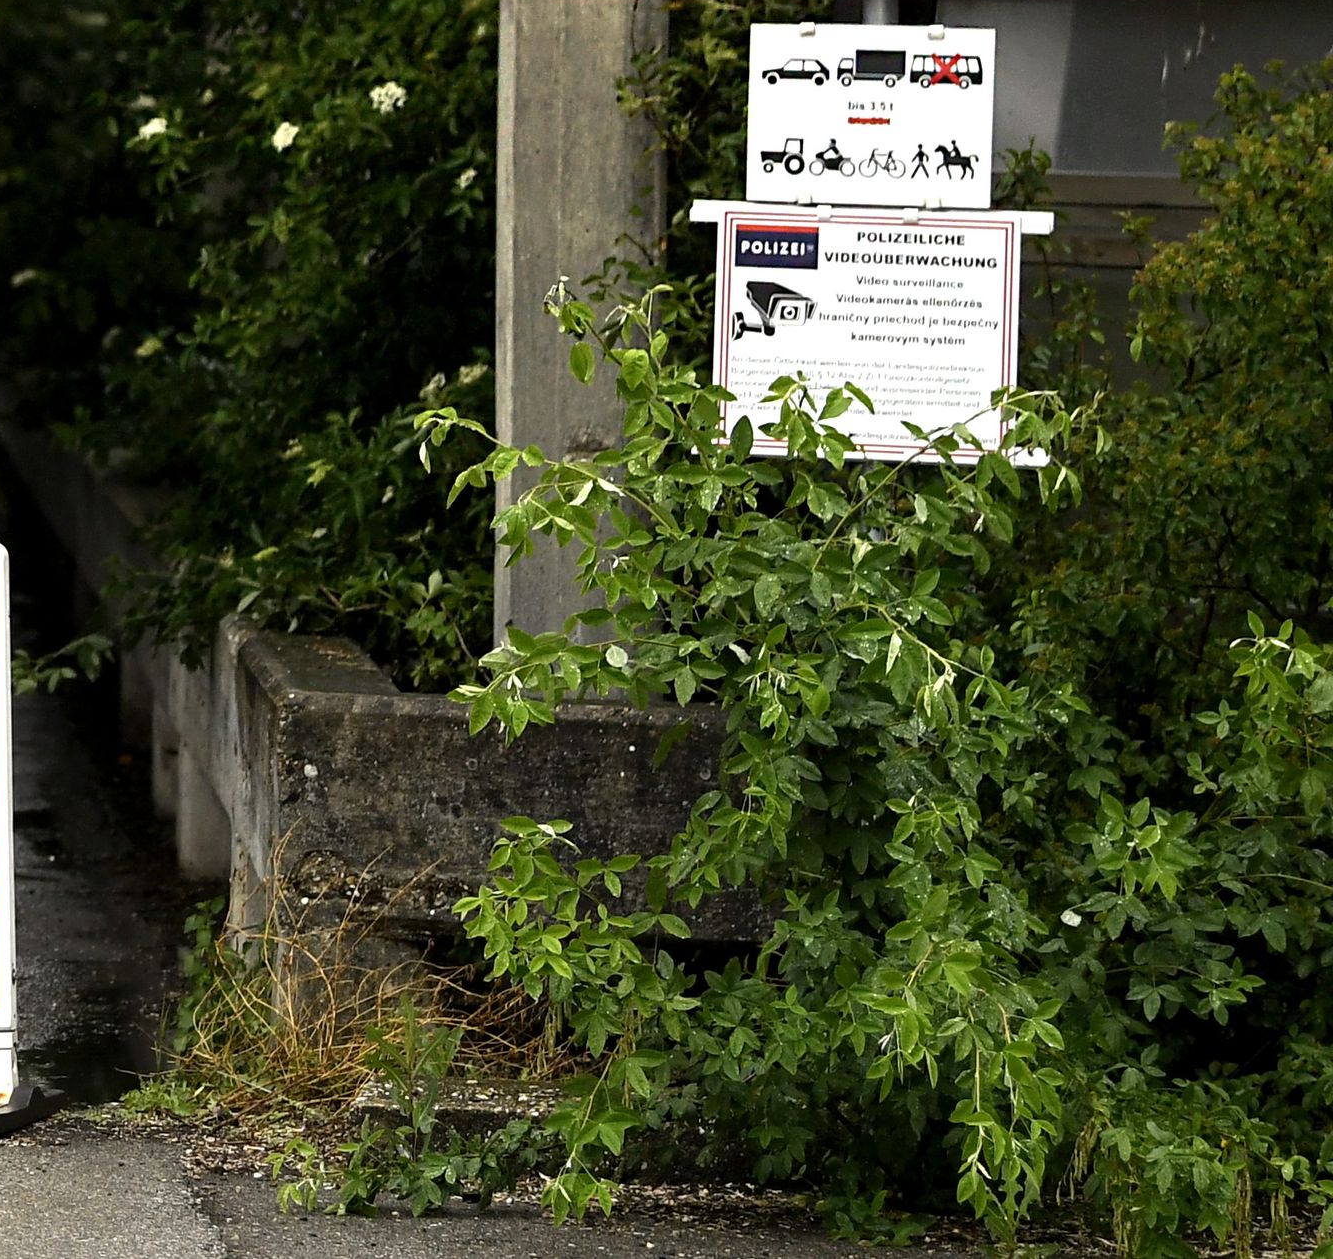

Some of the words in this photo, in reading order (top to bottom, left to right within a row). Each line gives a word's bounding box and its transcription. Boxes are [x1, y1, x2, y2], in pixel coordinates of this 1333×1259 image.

[856, 231, 966, 246] POLIZEILICHE
[740, 240, 806, 257] POLIZEI
[824, 251, 998, 269] VIDEOÜBERWACHUNG
[856, 275, 889, 286] Video
[892, 278, 964, 289] surveillance
[873, 314, 925, 325] priechod
[928, 316, 939, 328] je
